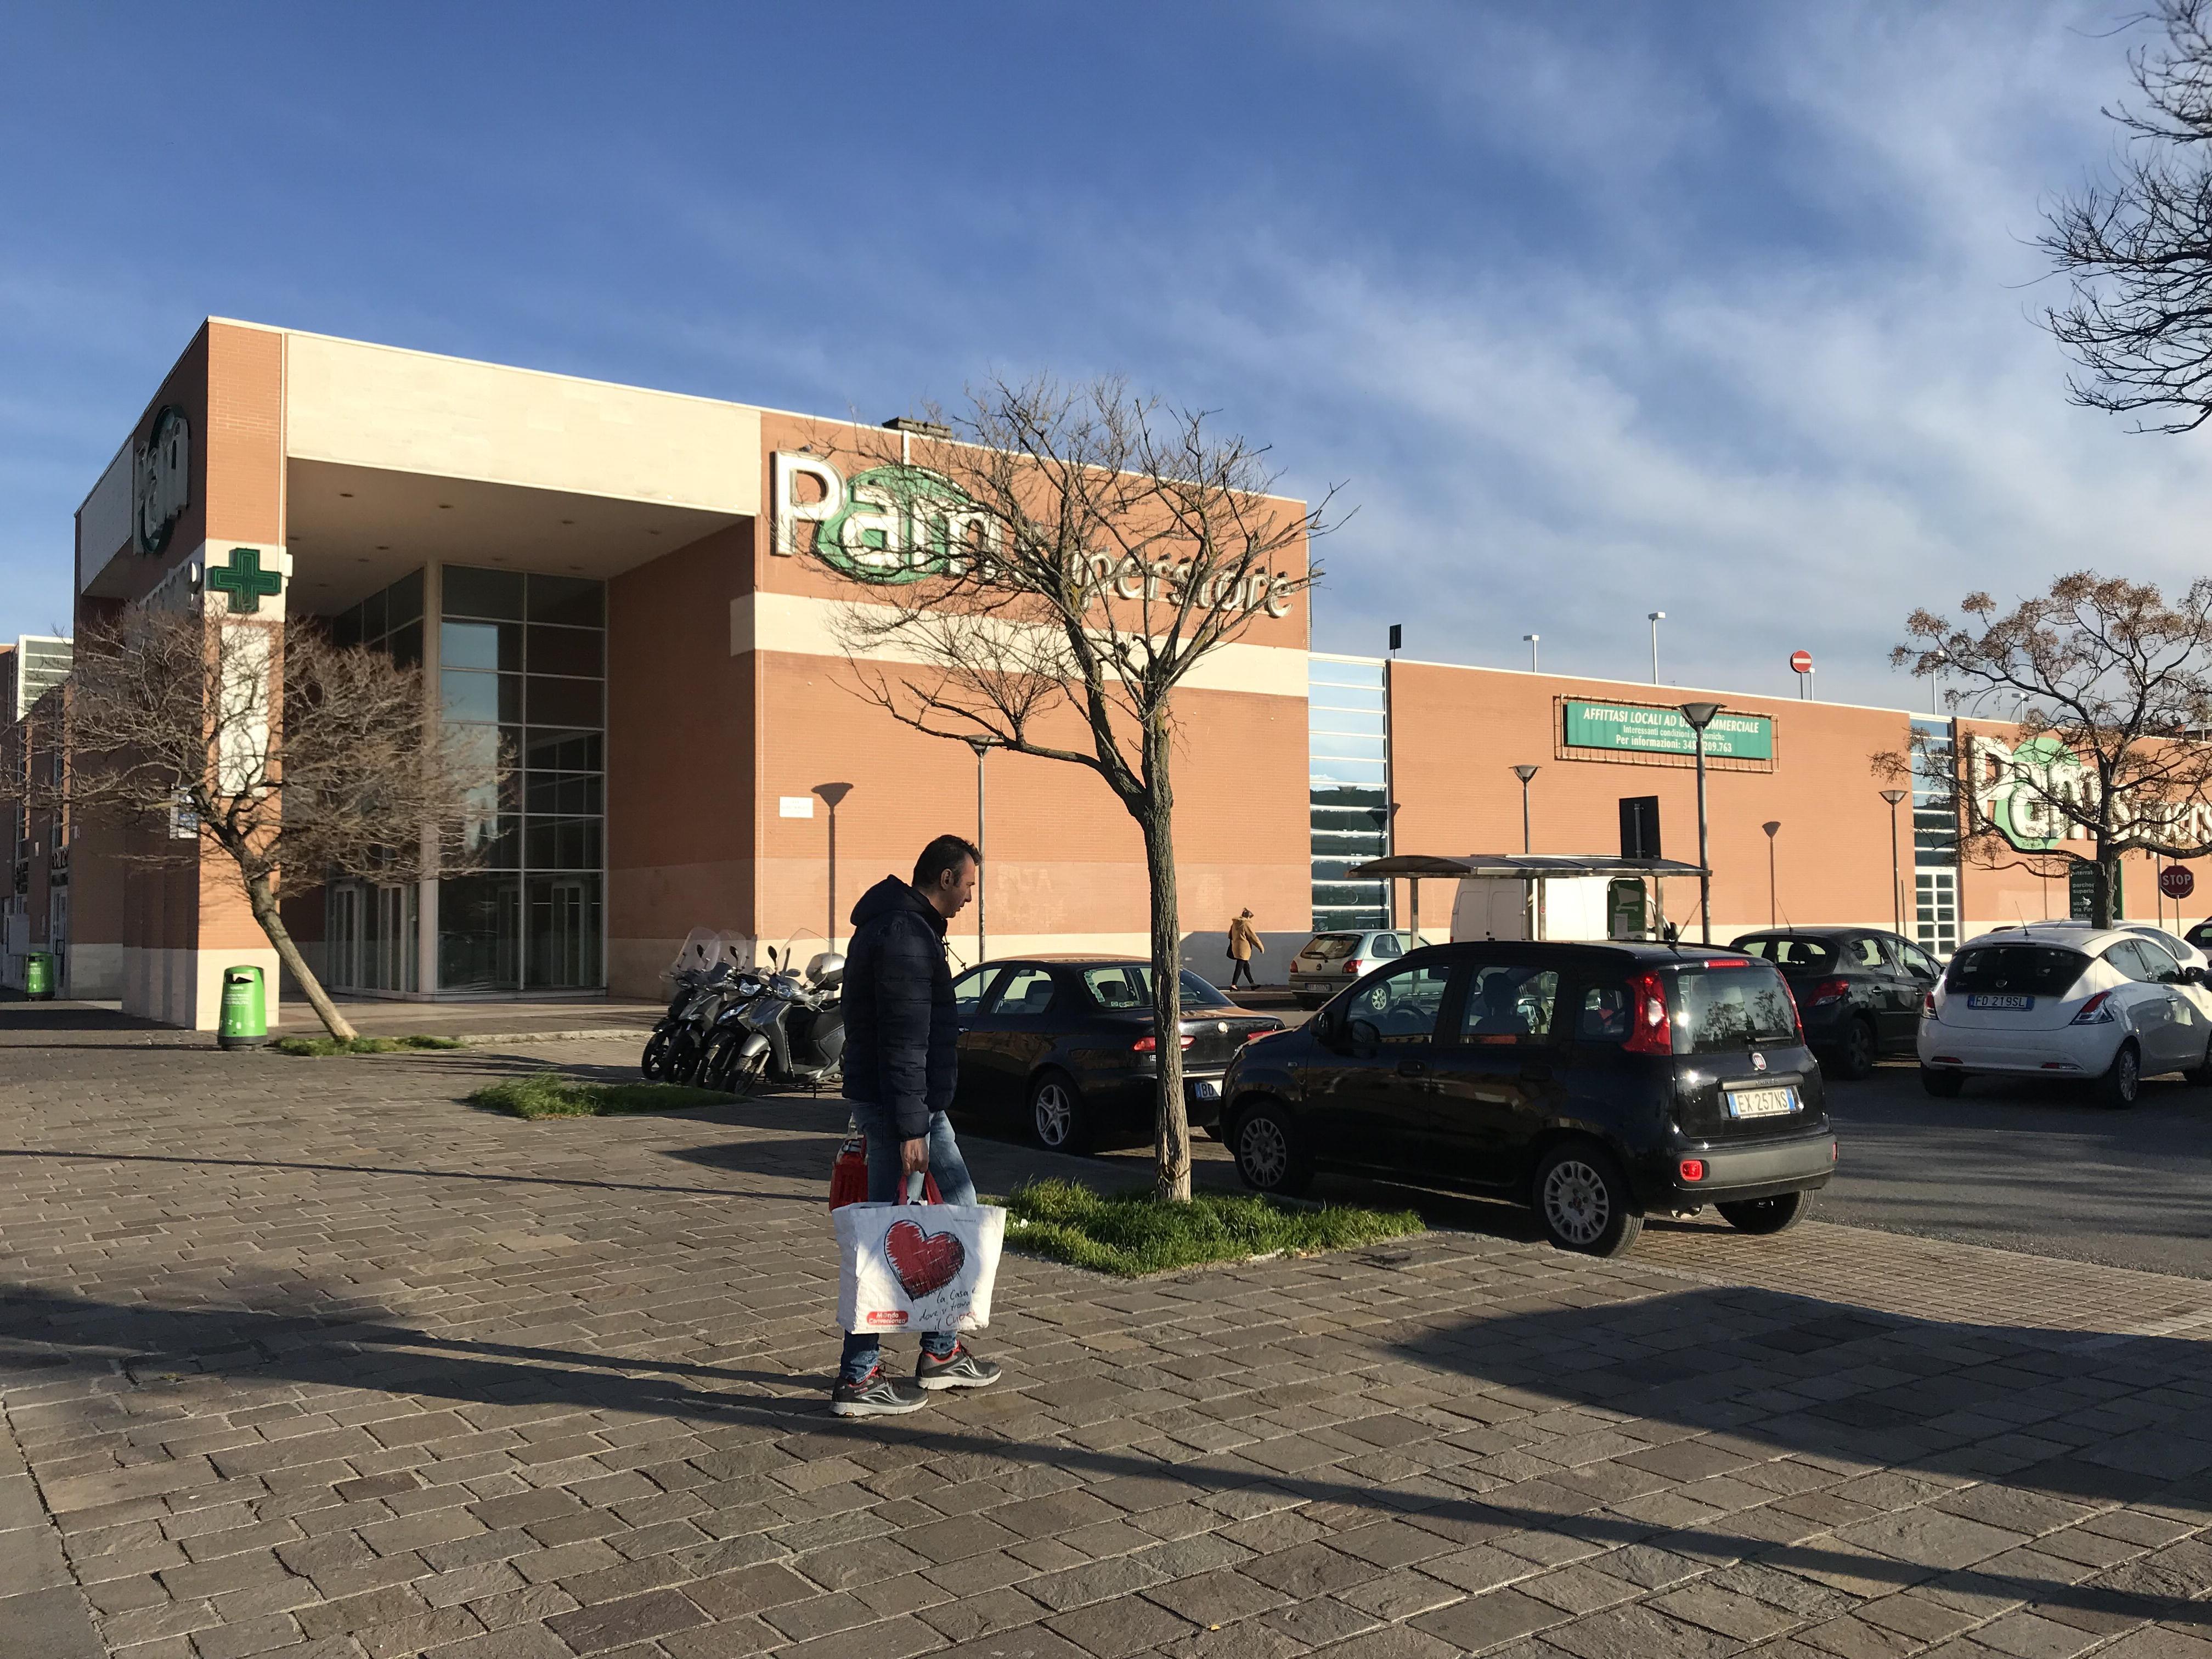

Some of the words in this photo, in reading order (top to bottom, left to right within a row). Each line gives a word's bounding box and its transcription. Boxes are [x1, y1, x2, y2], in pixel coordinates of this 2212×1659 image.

[775, 449, 1003, 584] Pam
[1012, 524, 1294, 618] perstore
[1583, 707, 1628, 723] AFFITTASI
[1630, 711, 1662, 725] LOCALI
[1663, 714, 1677, 727] AD
[1679, 715, 1690, 728] US
[1705, 719, 1759, 733] OMMERCIALE
[1623, 725, 1658, 736] Interessanti
[1660, 729, 1690, 738] condizioni
[1691, 732, 1725, 741] ecnomiche
[1616, 735, 1629, 745] Per
[1631, 736, 1681, 749] informazioni:
[1971, 736, 2102, 840] Pam
[2162, 874, 2191, 885] STOP
[1975, 996, 1988, 1006] FD
[1992, 996, 2024, 1007] 219SL
[1737, 1094, 1753, 1113] EX
[1755, 1091, 1788, 1111] 257NS
[936, 1290, 946, 1304] la
[950, 1289, 968, 1300] Casa
[919, 1308, 938, 1322] dove
[950, 1300, 970, 1311] trova
[934, 1317, 941, 1330] il
